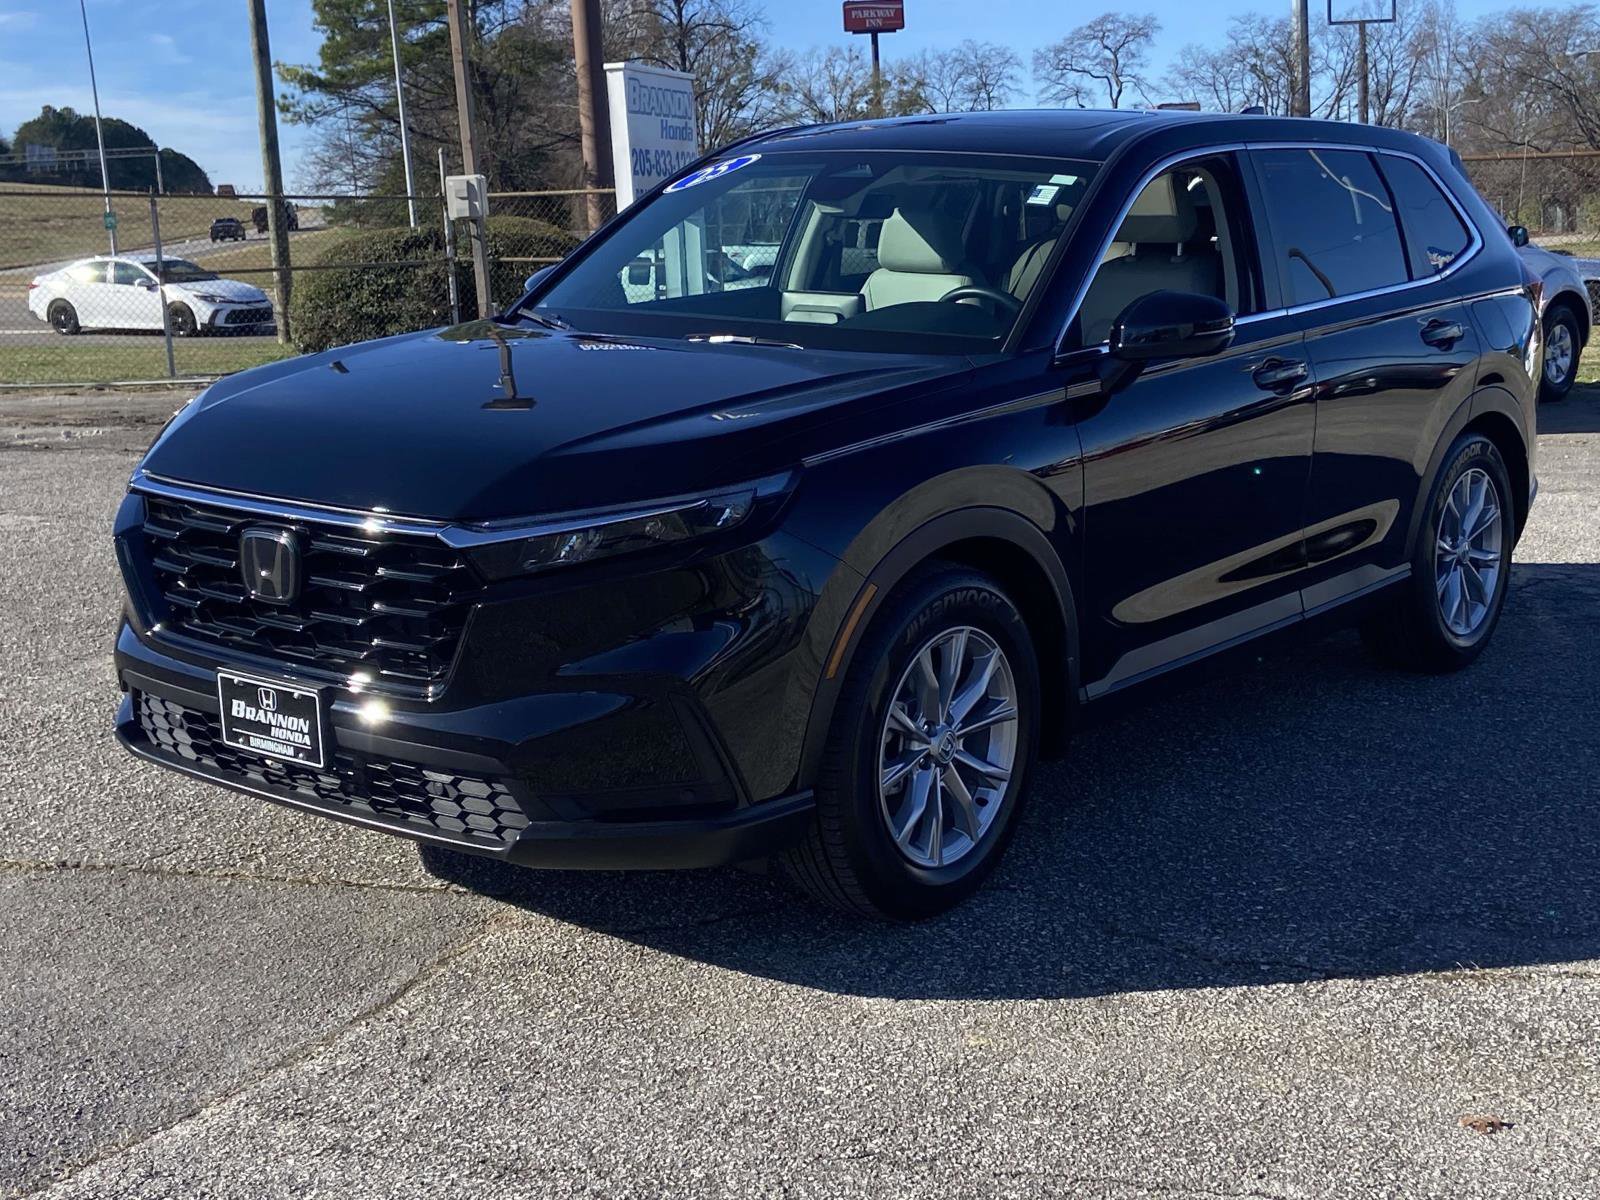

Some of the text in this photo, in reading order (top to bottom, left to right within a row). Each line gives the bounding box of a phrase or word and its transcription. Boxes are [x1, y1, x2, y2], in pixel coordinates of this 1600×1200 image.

[851, 9, 896, 18] PARKWAY
[865, 18, 883, 27] INN
[627, 77, 693, 120] BRANNON
[660, 119, 693, 141] Honda
[231, 698, 310, 733] BRANNON
[249, 736, 295, 757] BIRMINGHAM
[270, 726, 311, 746] HONDA
